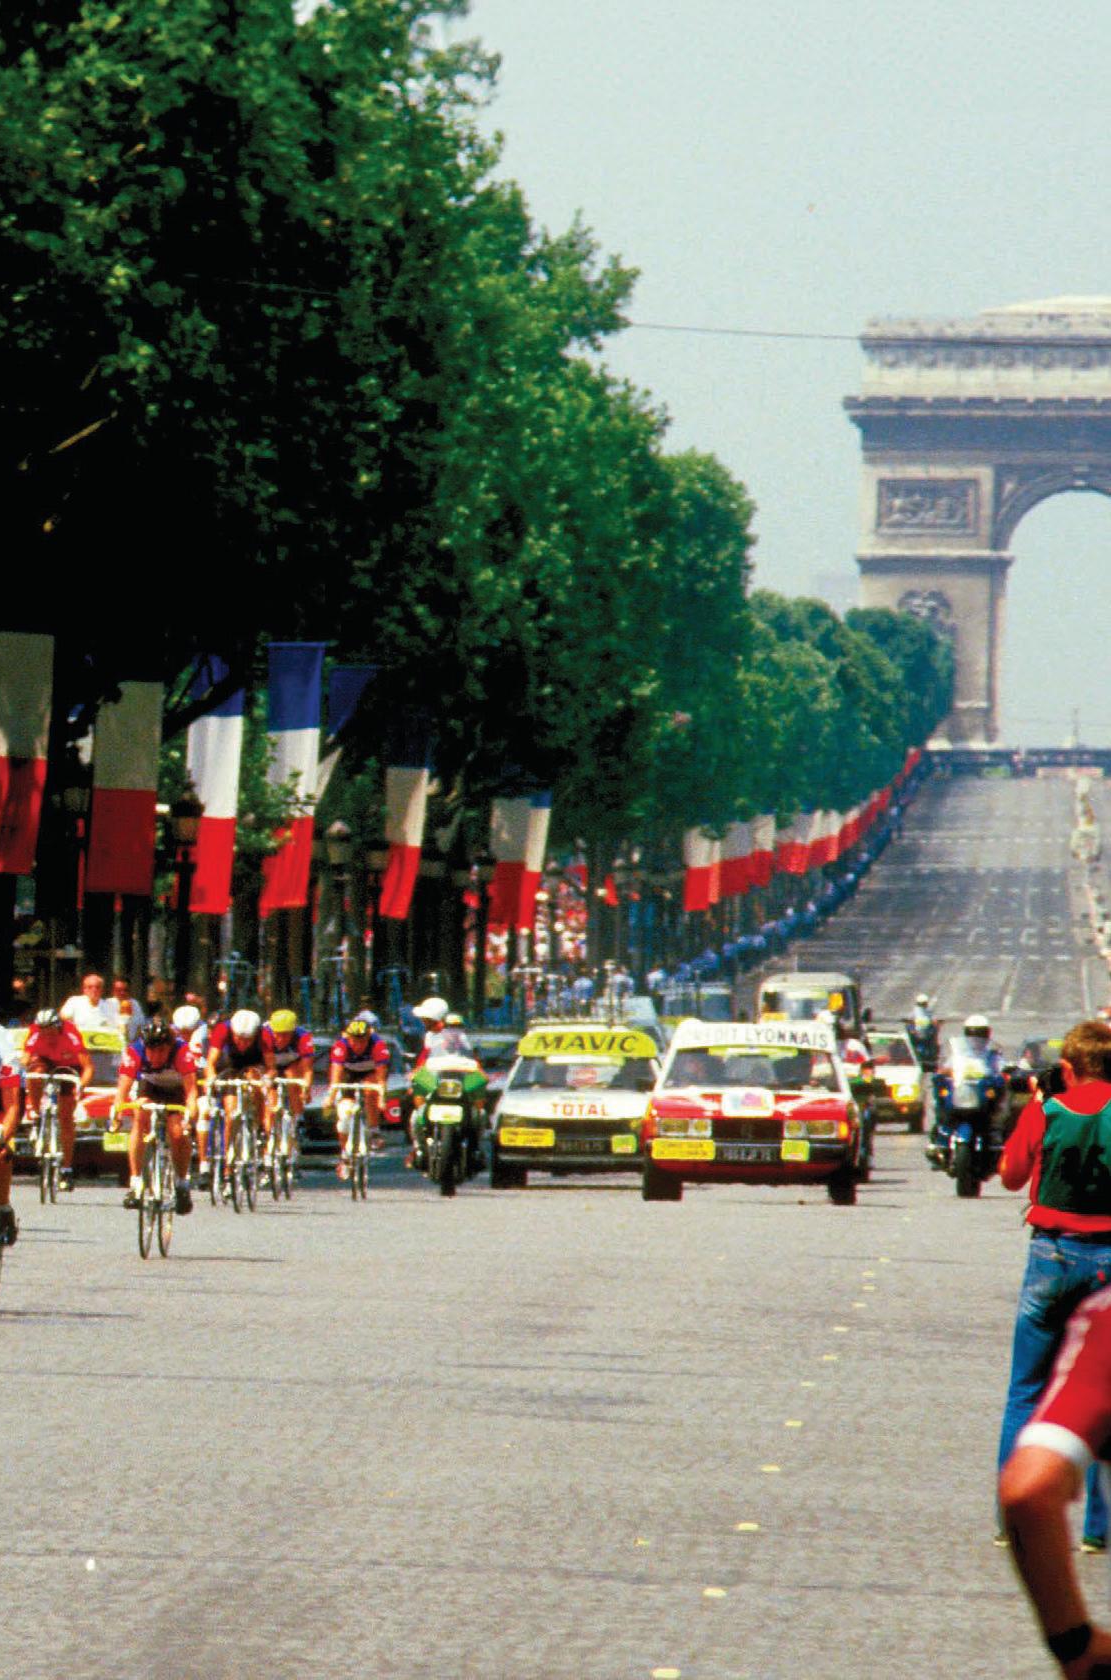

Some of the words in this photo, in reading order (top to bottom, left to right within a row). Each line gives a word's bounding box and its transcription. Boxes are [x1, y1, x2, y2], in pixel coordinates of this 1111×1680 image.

[534, 1034, 640, 1053] MAVIC
[744, 1027, 829, 1048] LYONNAIS
[550, 1102, 610, 1117] TOTAL
